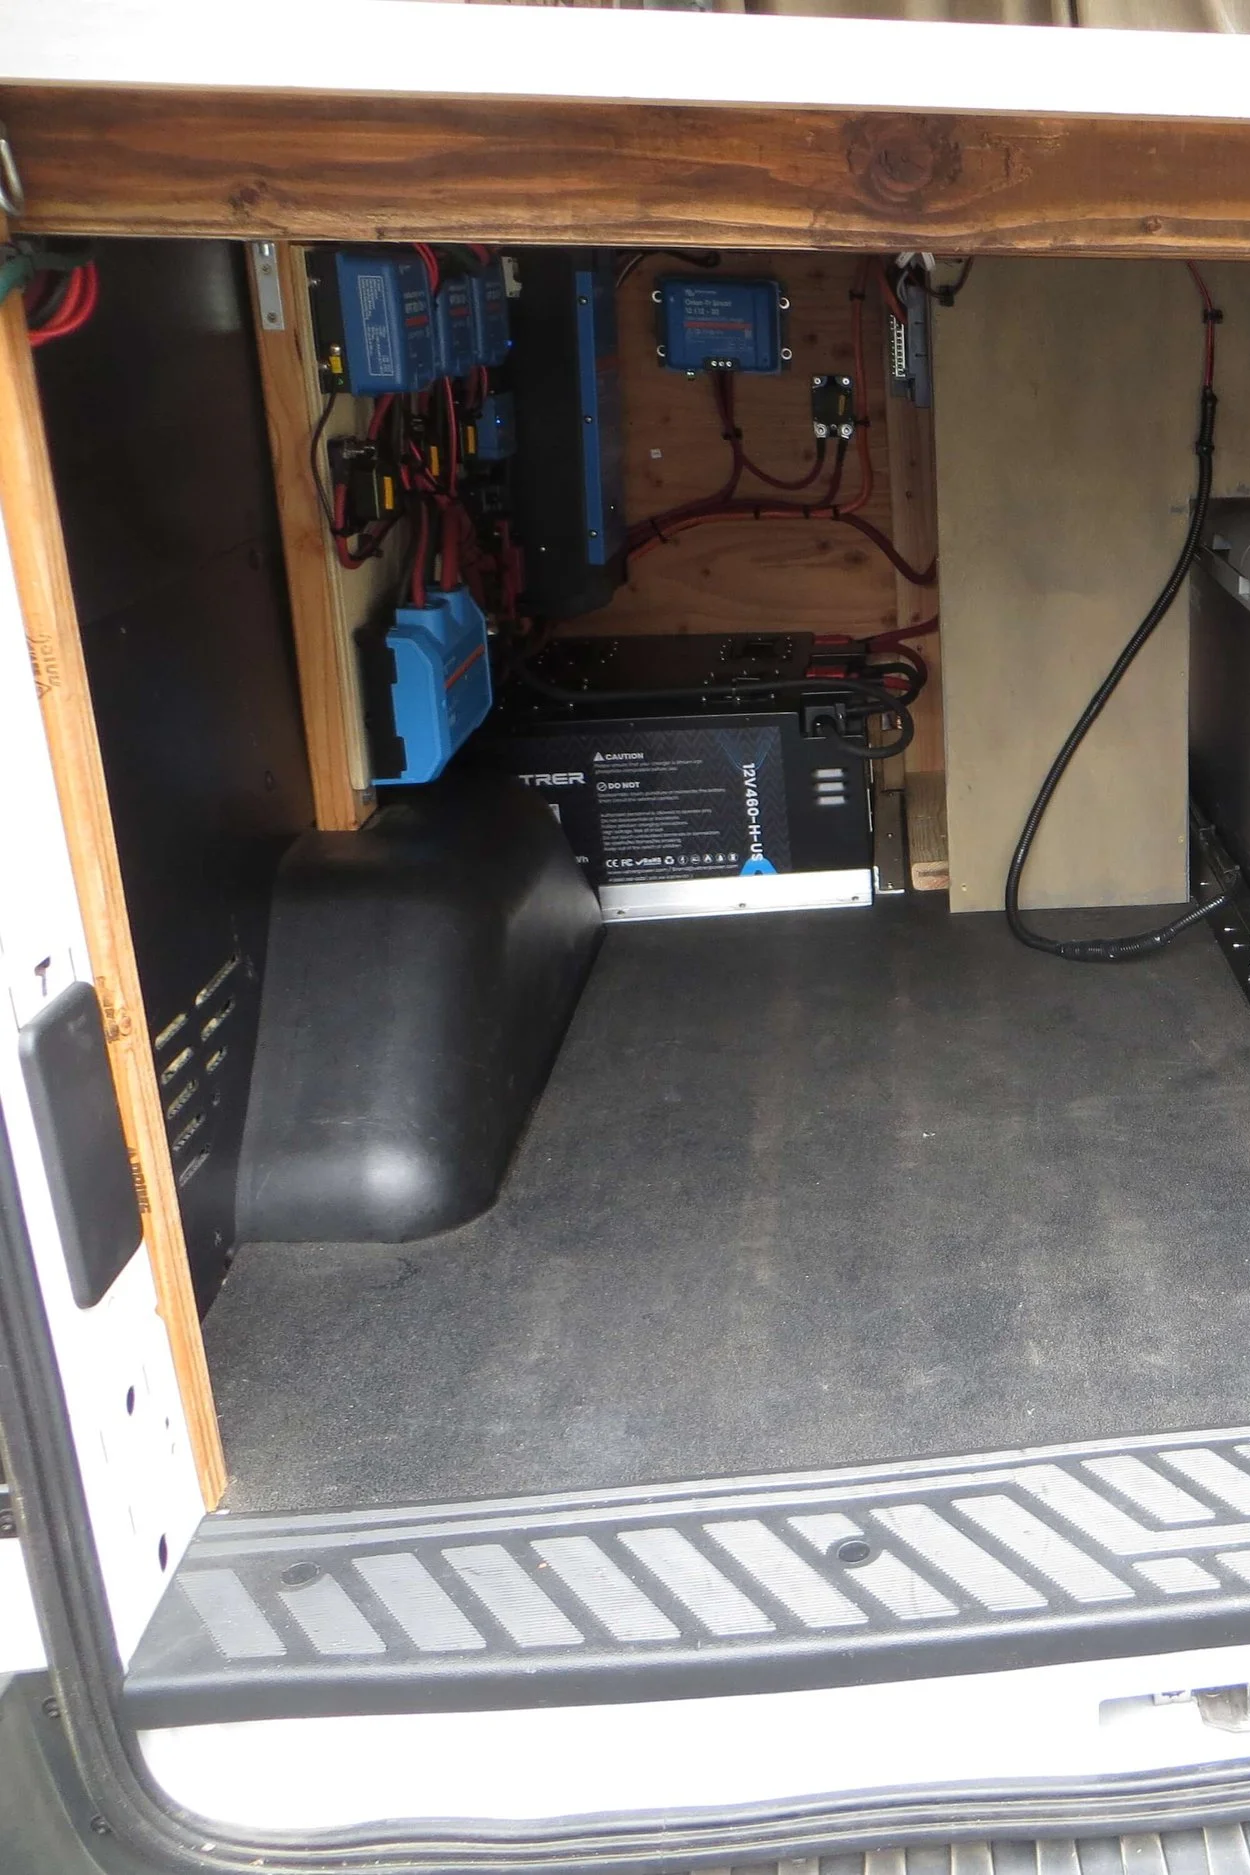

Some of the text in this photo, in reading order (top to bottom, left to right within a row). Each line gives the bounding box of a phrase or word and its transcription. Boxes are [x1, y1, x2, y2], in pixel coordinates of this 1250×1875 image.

[605, 752, 644, 761] CAUTION
[518, 772, 586, 786] TRER
[608, 781, 641, 790] DO NOT
[742, 763, 763, 862] 12V460-H-US
